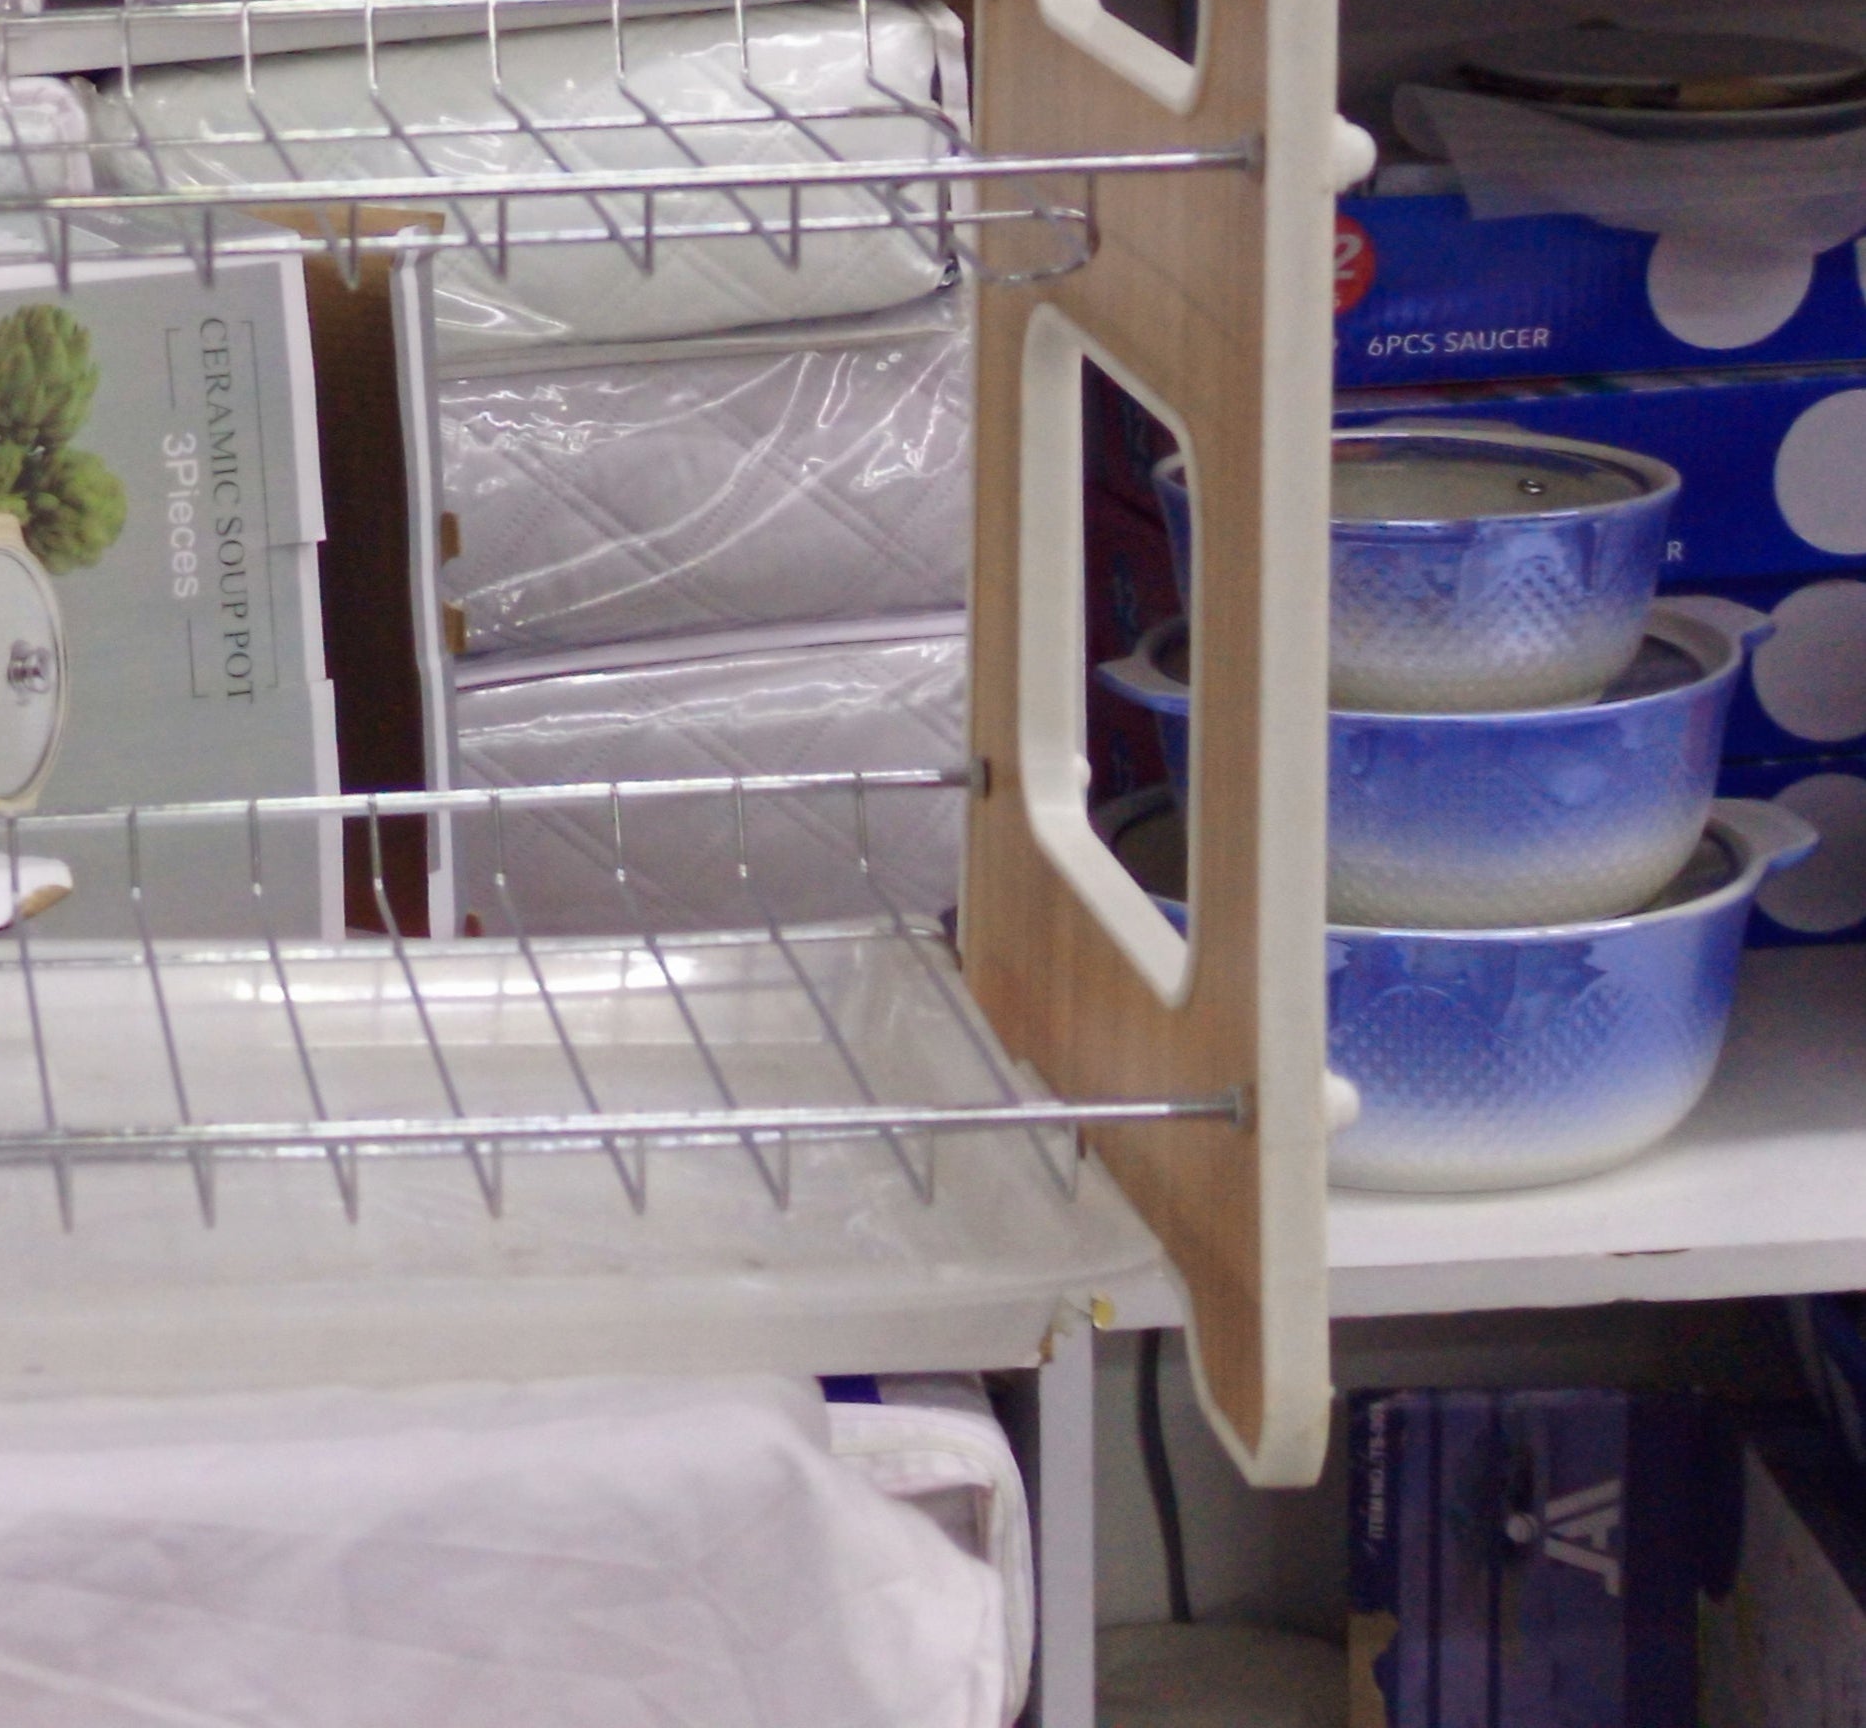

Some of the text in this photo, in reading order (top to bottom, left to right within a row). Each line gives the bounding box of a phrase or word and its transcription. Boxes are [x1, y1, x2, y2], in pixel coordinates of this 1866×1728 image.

[1368, 328, 1549, 356] 6PCS SAUCER
[162, 431, 199, 598] 3Pieces
[199, 317, 255, 704] CERAMIC SOUP POT
